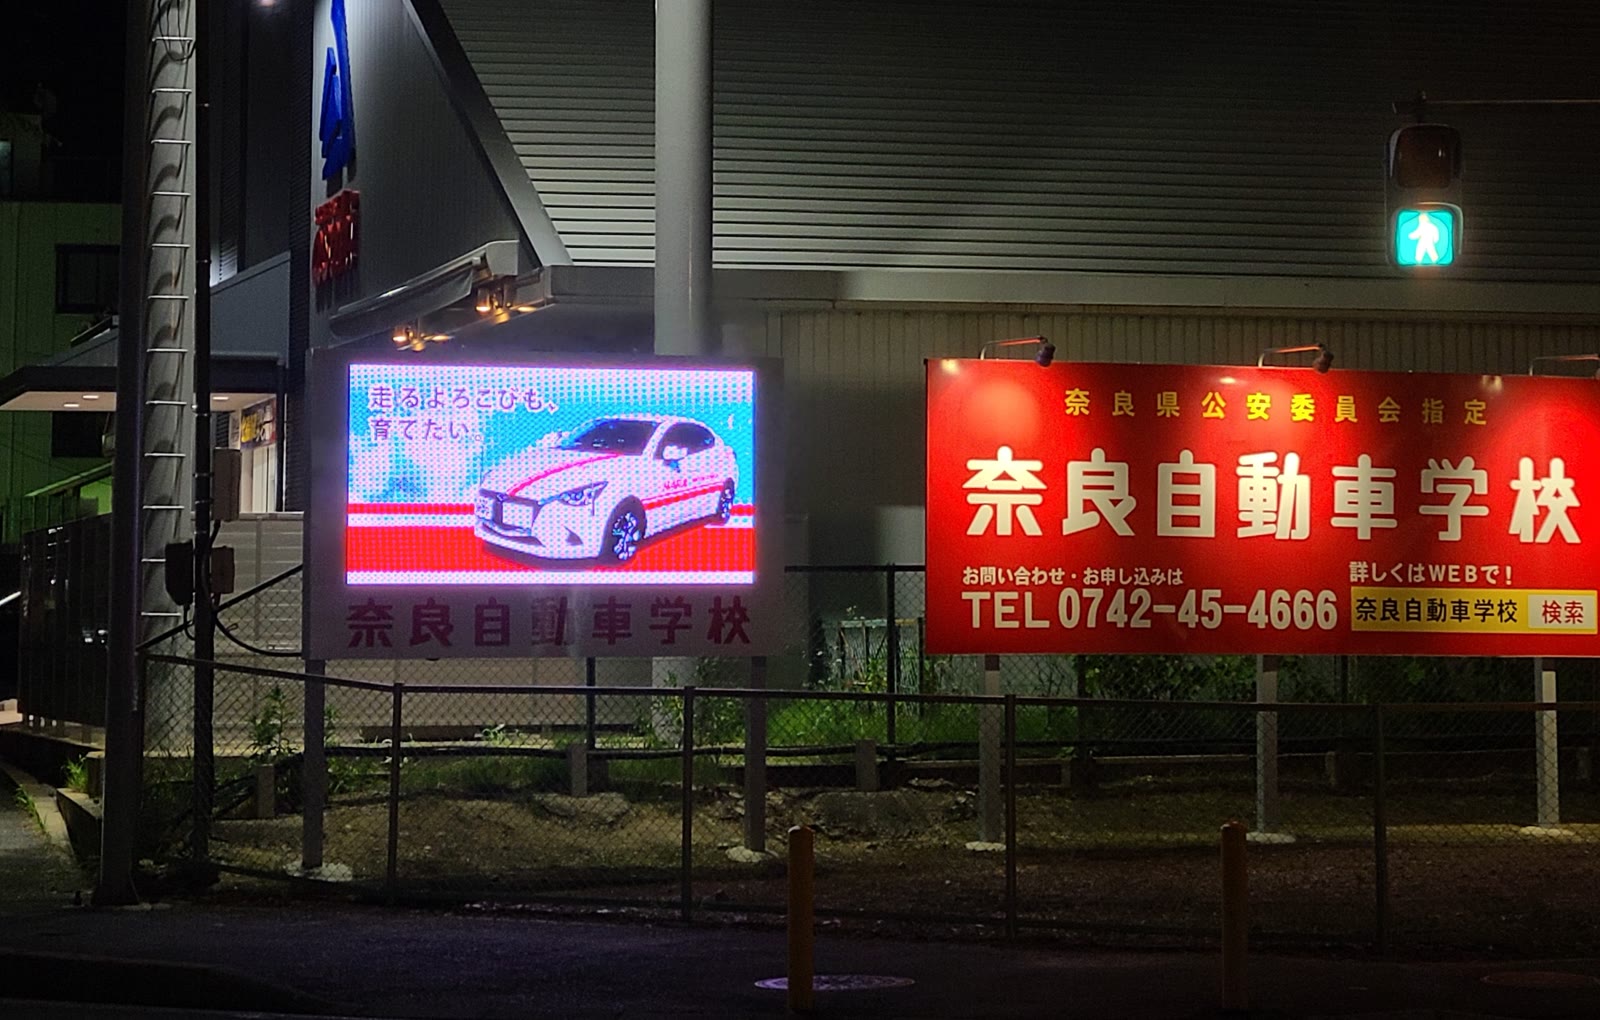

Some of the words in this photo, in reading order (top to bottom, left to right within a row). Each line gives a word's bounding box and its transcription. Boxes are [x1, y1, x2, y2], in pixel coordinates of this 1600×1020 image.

[370, 386, 557, 411] 走るよろこびも、
[1064, 388, 1488, 425] 奈良県公安委員会指定
[370, 418, 482, 441] 育てたい。
[962, 446, 1581, 544] 奈良自動車学校
[962, 566, 1184, 586] お問い合わせ・お申し込みは
[961, 591, 1050, 629] TEL
[1058, 587, 1338, 630] 0742-45-4666
[1355, 596, 1518, 623] 奈良自動車学校
[1541, 600, 1584, 625] 検索
[346, 597, 752, 648] 奈良自動車学校
